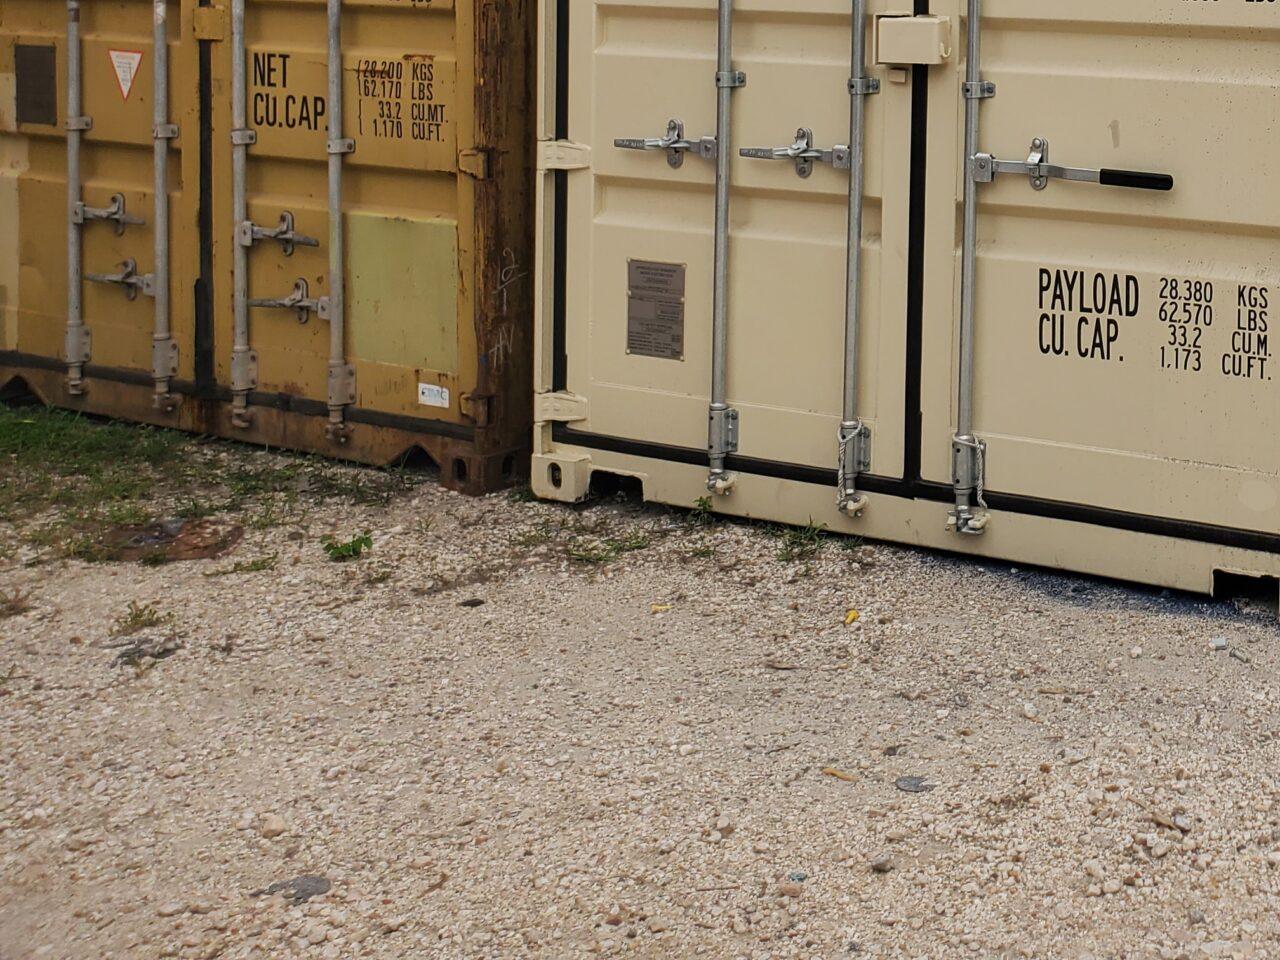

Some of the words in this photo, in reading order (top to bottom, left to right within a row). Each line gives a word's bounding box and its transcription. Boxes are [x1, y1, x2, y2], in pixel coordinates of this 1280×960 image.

[253, 52, 290, 88] NET
[412, 62, 434, 82] KGS
[411, 82, 433, 101] LBS
[378, 100, 402, 120] 33.2
[411, 102, 449, 123] CU.MT.
[411, 121, 445, 142] CU.FT.
[1039, 268, 1139, 317] PAYLOAD
[1237, 284, 1268, 309] KGS
[1237, 308, 1268, 333] LBS
[1168, 324, 1202, 349] 33.2
[1231, 331, 1272, 357] CU.M.
[1221, 353, 1272, 381] CU.FT.
